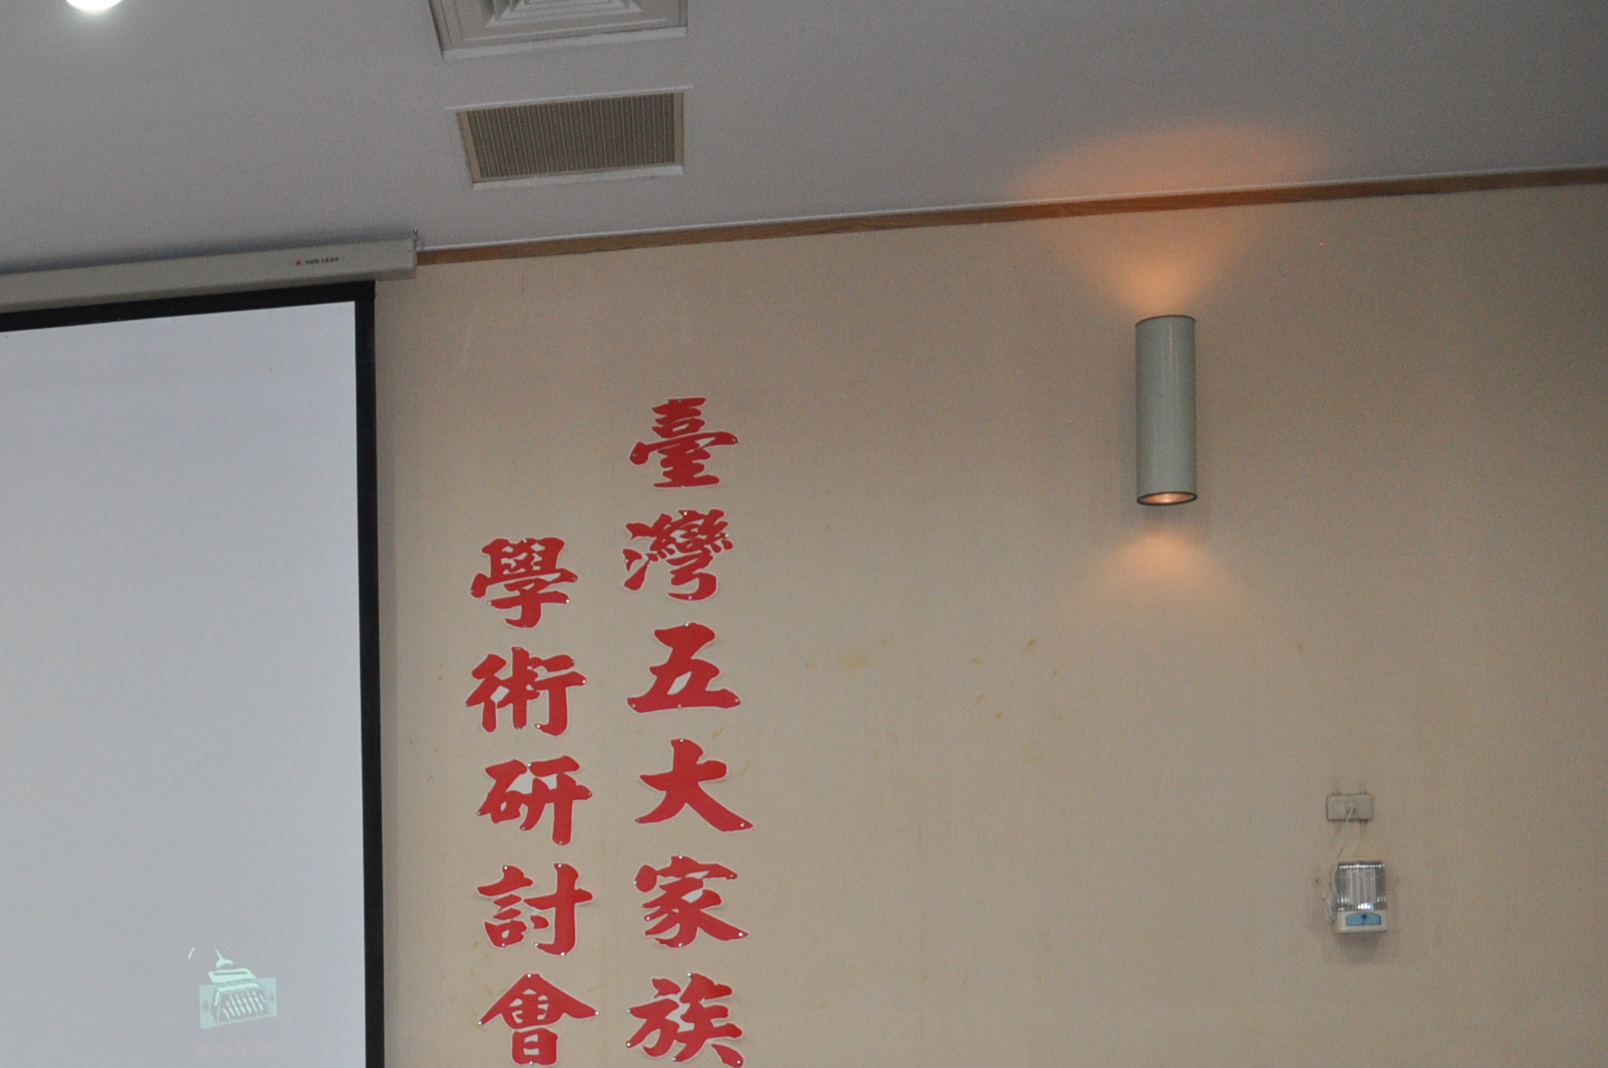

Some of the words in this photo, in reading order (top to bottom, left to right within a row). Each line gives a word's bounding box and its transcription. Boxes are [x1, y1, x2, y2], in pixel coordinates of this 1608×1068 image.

[465, 536, 599, 1067] 學術研討會
[622, 397, 753, 1068] 臺灣五大家族
